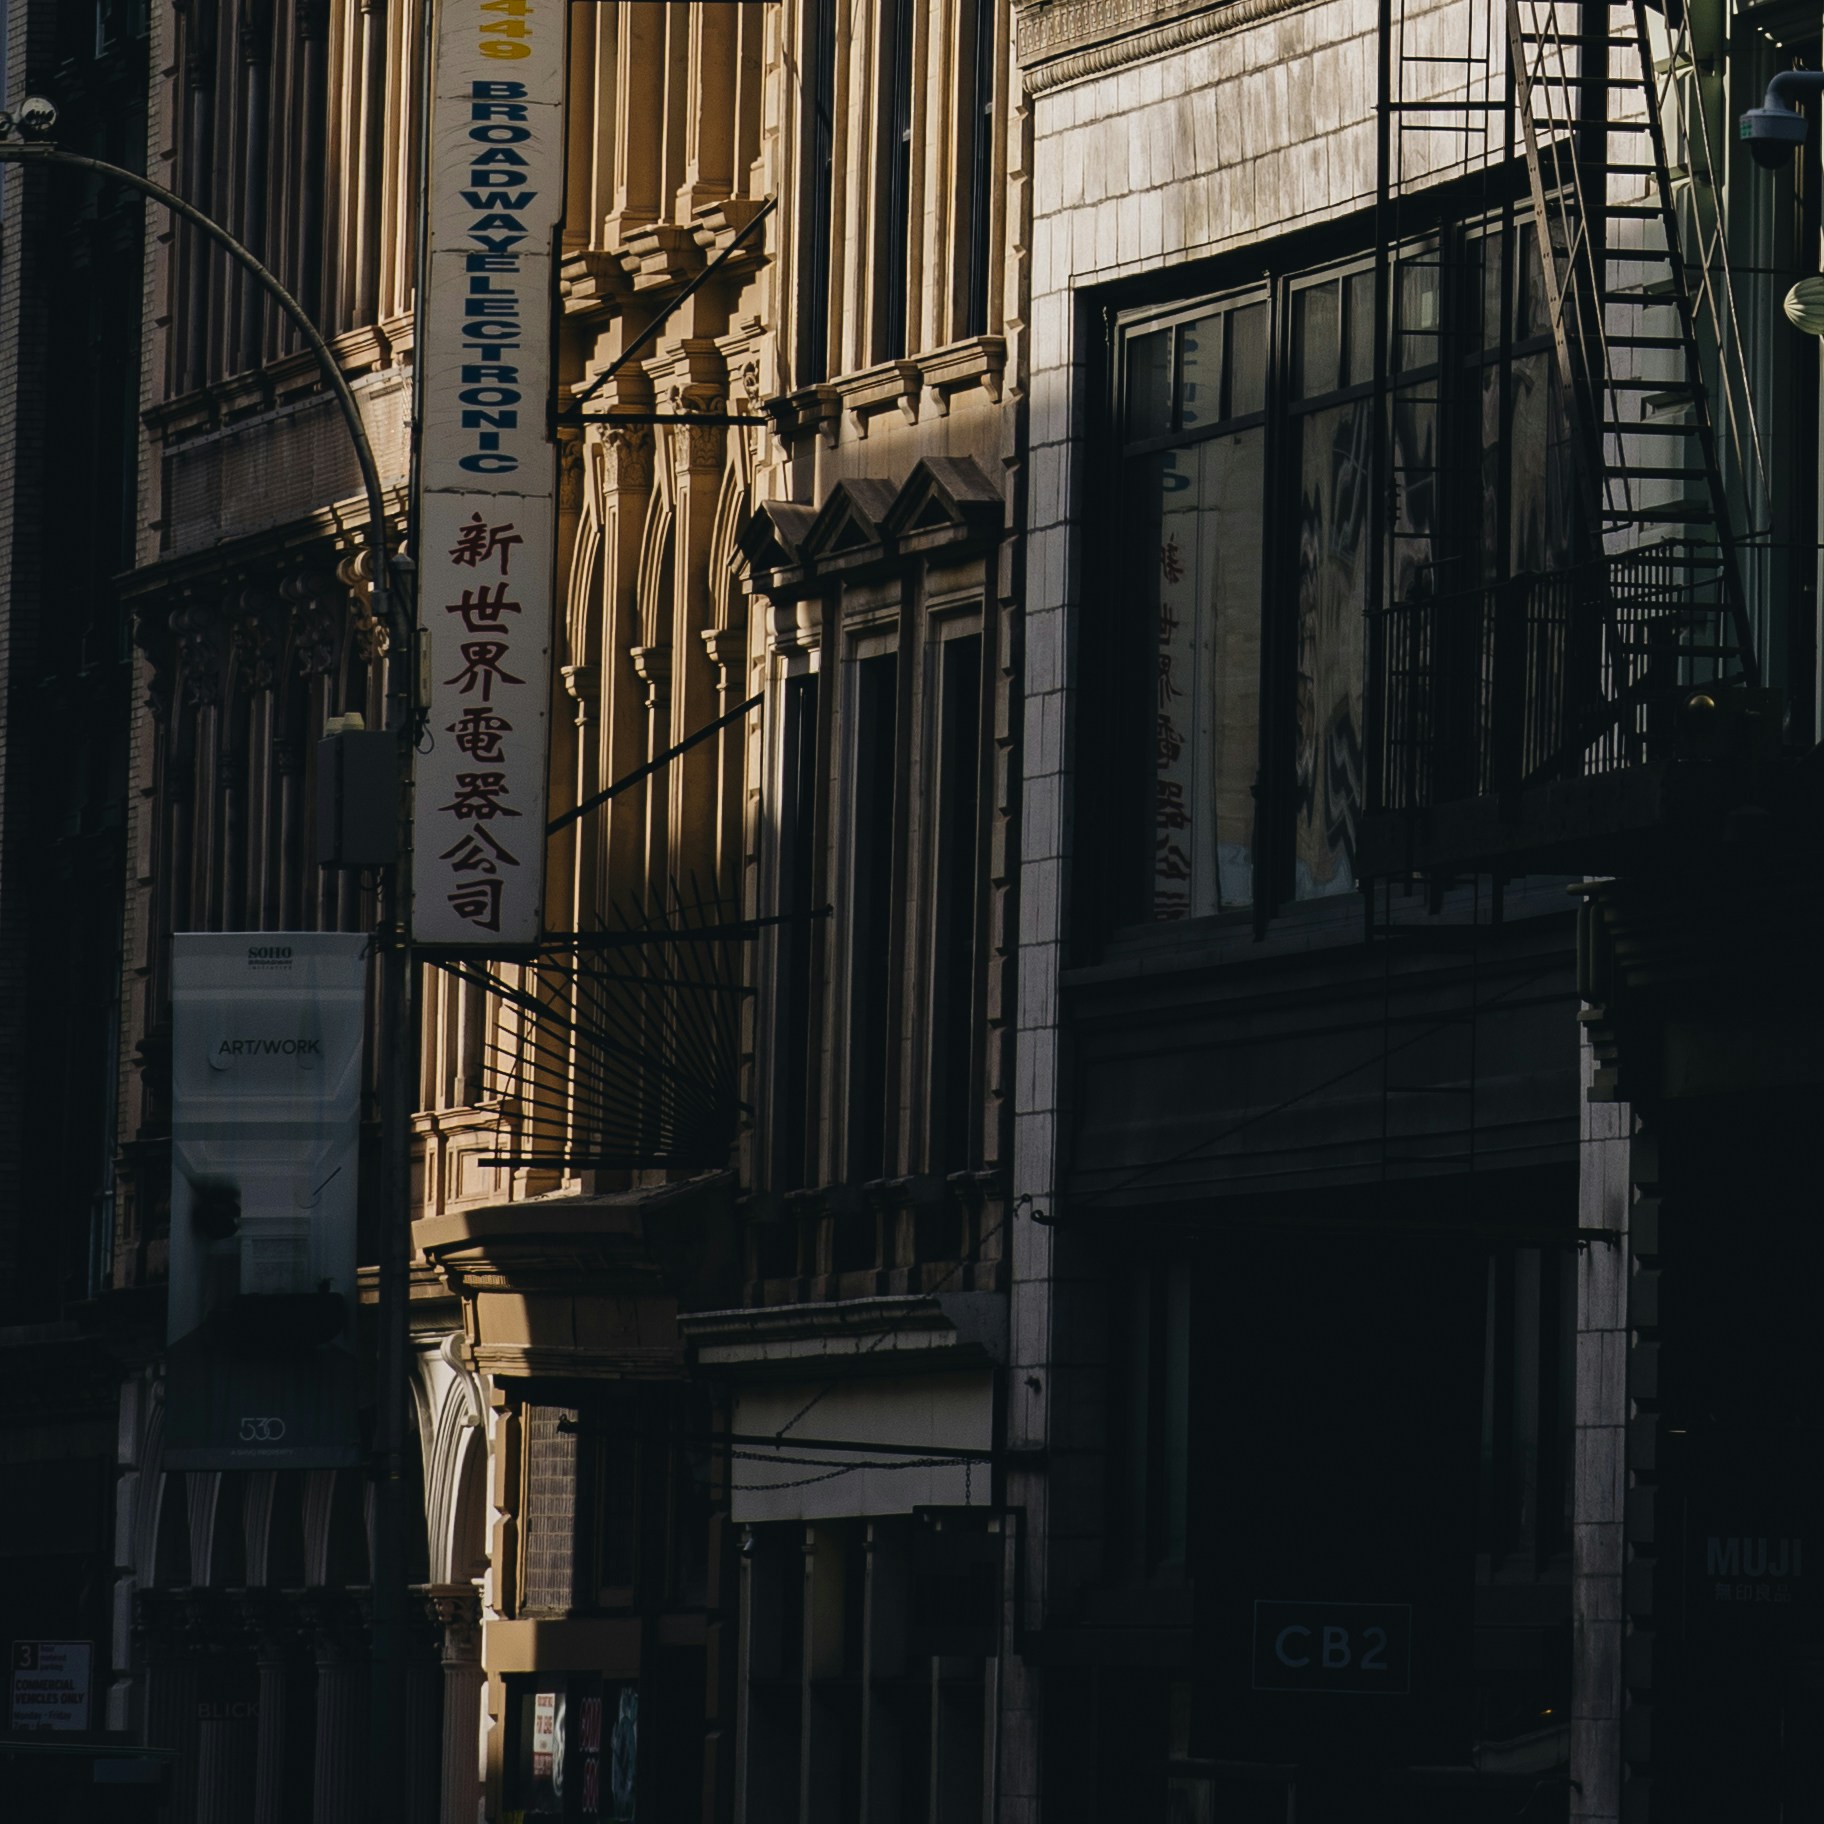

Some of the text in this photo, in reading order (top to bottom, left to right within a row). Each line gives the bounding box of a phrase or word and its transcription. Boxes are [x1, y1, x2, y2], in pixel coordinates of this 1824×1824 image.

[459, 80, 538, 253] BROADWAY
[458, 254, 522, 474] ELECTRONIC
[438, 512, 526, 933] 新世界電器公司
[248, 946, 292, 958] SOHO
[218, 1039, 320, 1055] ART/WORK
[239, 1417, 286, 1441] 530
[1707, 1537, 1802, 1577] MUJI
[19, 1645, 32, 1667] 3
[1274, 1624, 1389, 1670] CB2
[15, 1679, 75, 1691] COMMERCIAL
[15, 1692, 85, 1704] VEHICLES ONLY
[198, 1702, 259, 1719] BLICK
